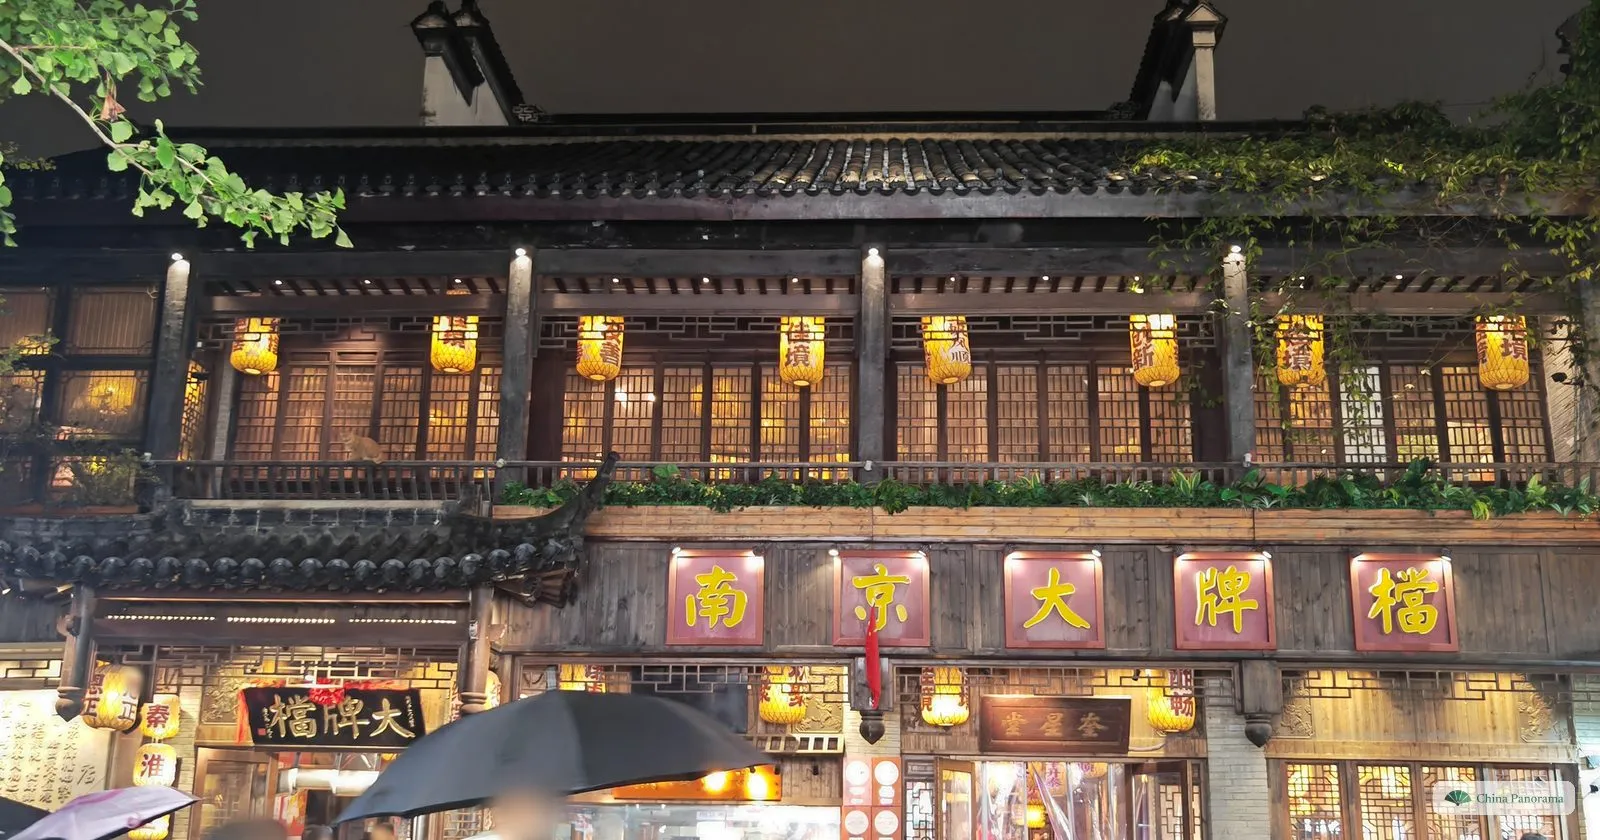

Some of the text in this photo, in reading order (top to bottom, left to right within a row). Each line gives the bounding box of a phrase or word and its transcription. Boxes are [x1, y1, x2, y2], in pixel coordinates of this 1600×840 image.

[684, 564, 1440, 636] 南京大牌檔
[269, 693, 416, 740] 大牌檔
